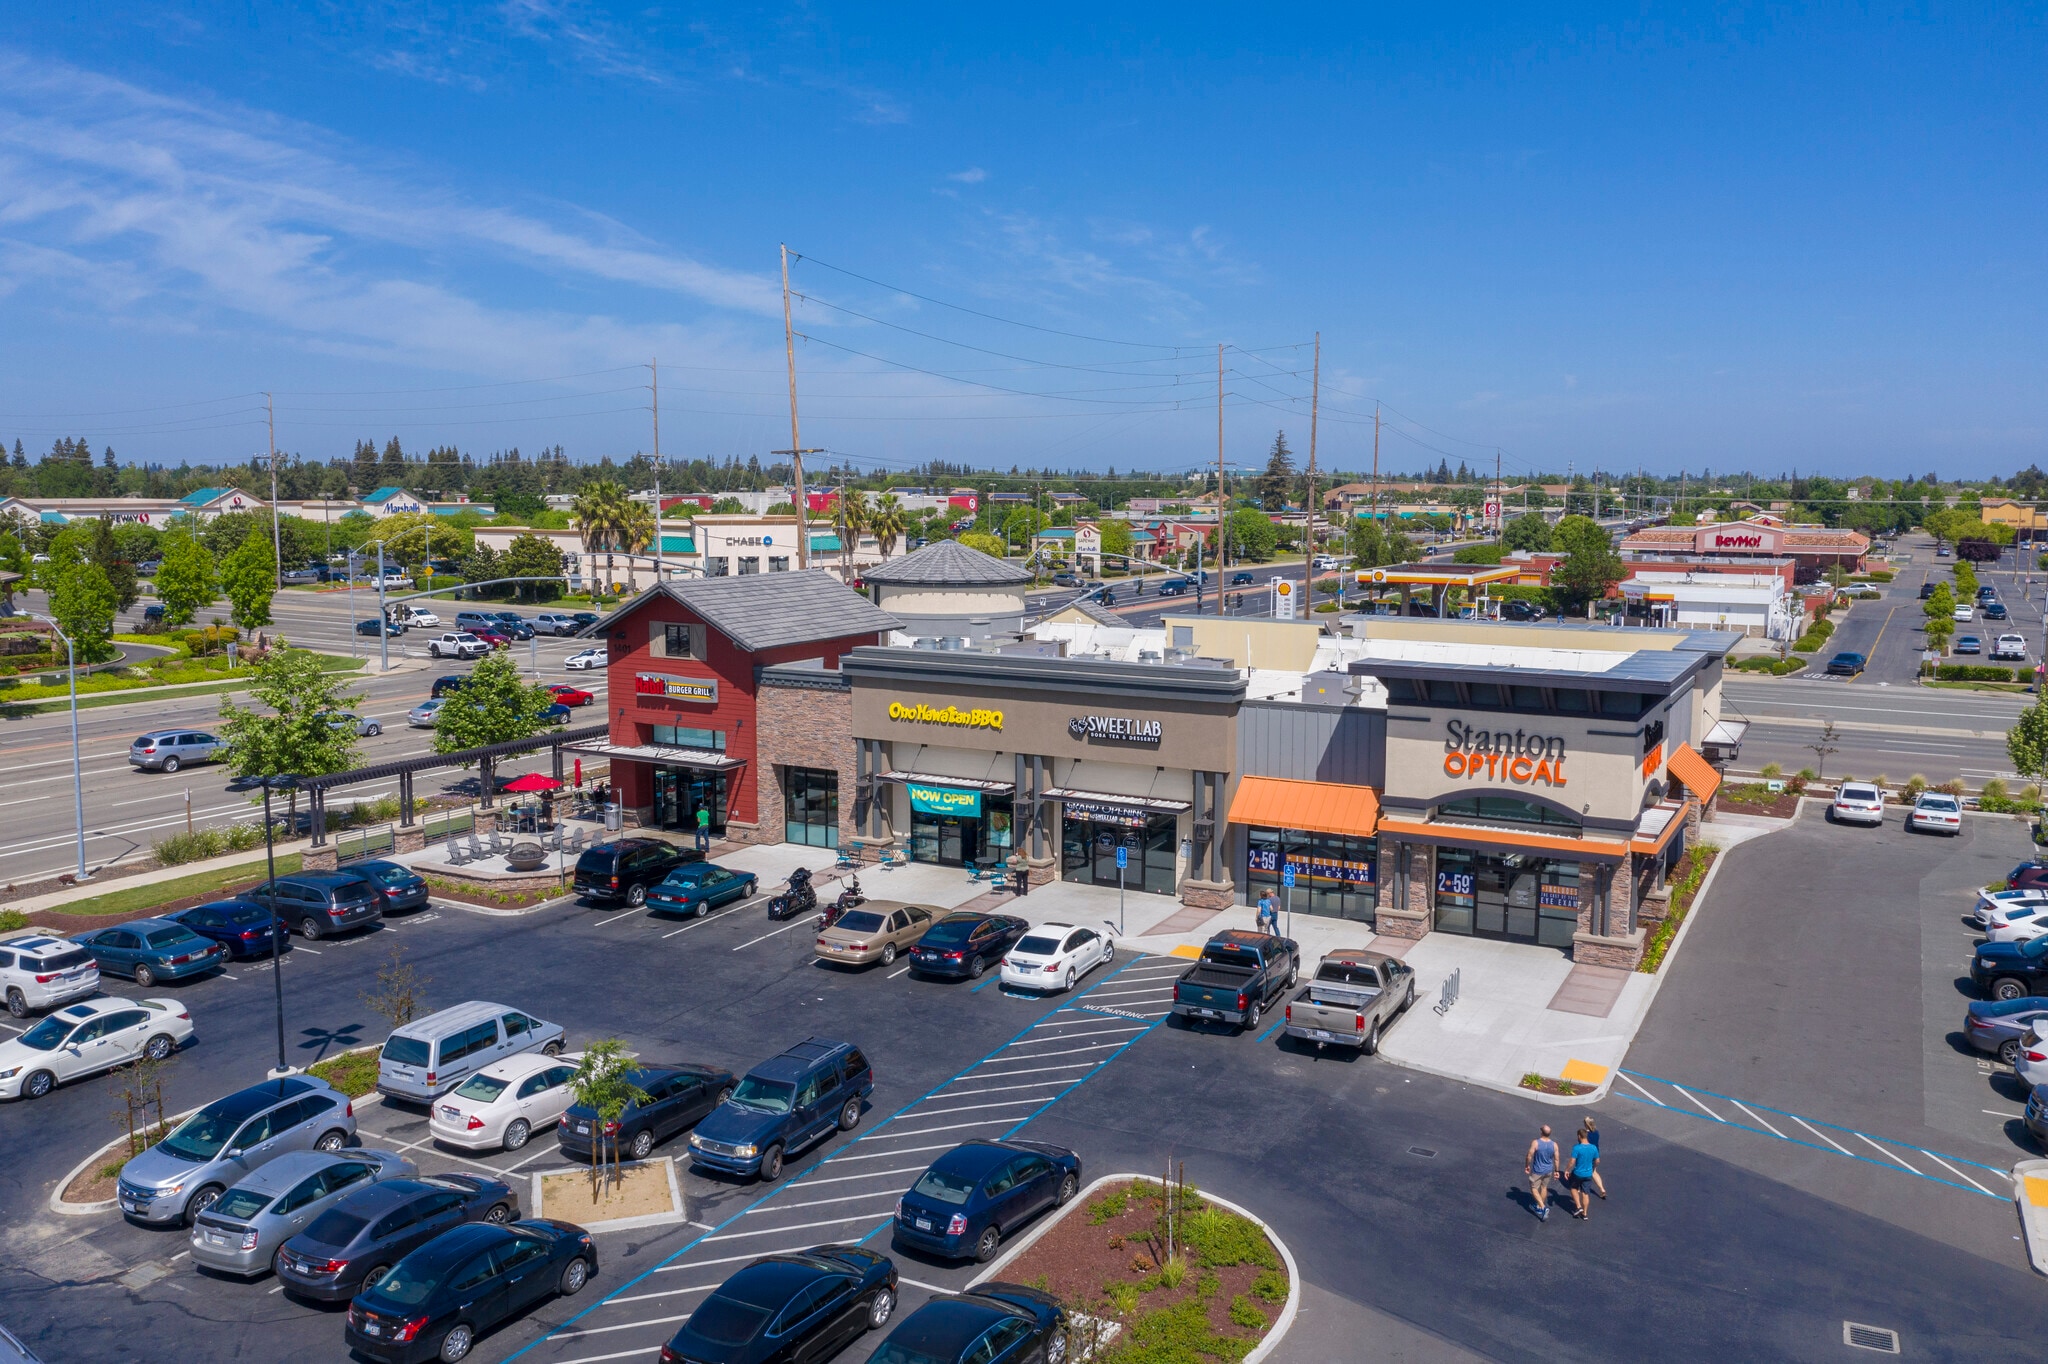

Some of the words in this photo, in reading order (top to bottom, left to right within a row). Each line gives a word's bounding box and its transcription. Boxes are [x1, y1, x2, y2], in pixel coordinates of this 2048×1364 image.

[726, 537, 762, 546] CHASE
[1715, 535, 1762, 548] BevMo!
[635, 676, 665, 696] Habit
[668, 685, 692, 695] BURGER
[693, 687, 710, 697] GRILL
[889, 702, 917, 721] Ono
[971, 709, 1004, 730] BBQ
[1088, 716, 1132, 735] SWEET
[1136, 720, 1161, 737] LAB
[1129, 735, 1158, 743] DESSERTS
[1446, 719, 1567, 759] Stanton
[1444, 751, 1567, 784] OPTICAL
[911, 788, 941, 803] NOW
[943, 793, 975, 806] OPEN
[1067, 802, 1099, 812] GRAND
[1101, 806, 1147, 818] OPENING
[1296, 867, 1314, 876] YE
[1326, 870, 1369, 882] EXAM
[1540, 897, 1554, 905] EYE
[1558, 899, 1578, 908] EXAM
[1100, 1006, 1146, 1019] PARKING
